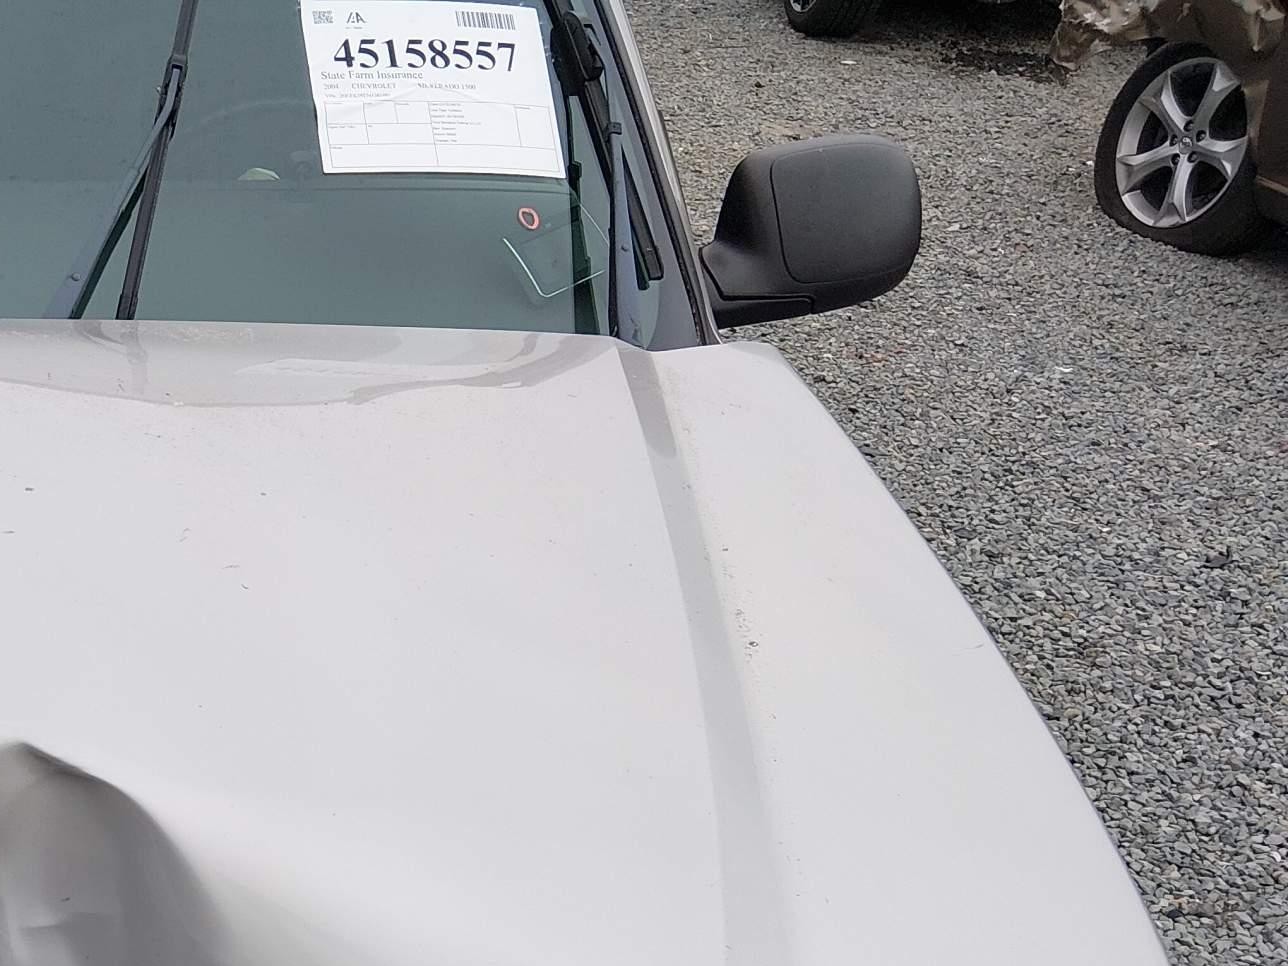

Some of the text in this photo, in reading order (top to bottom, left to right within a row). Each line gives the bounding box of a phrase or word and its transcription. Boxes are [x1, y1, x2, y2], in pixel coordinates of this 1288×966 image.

[333, 38, 516, 72] 45158557
[321, 70, 423, 80] State Farm Insurance
